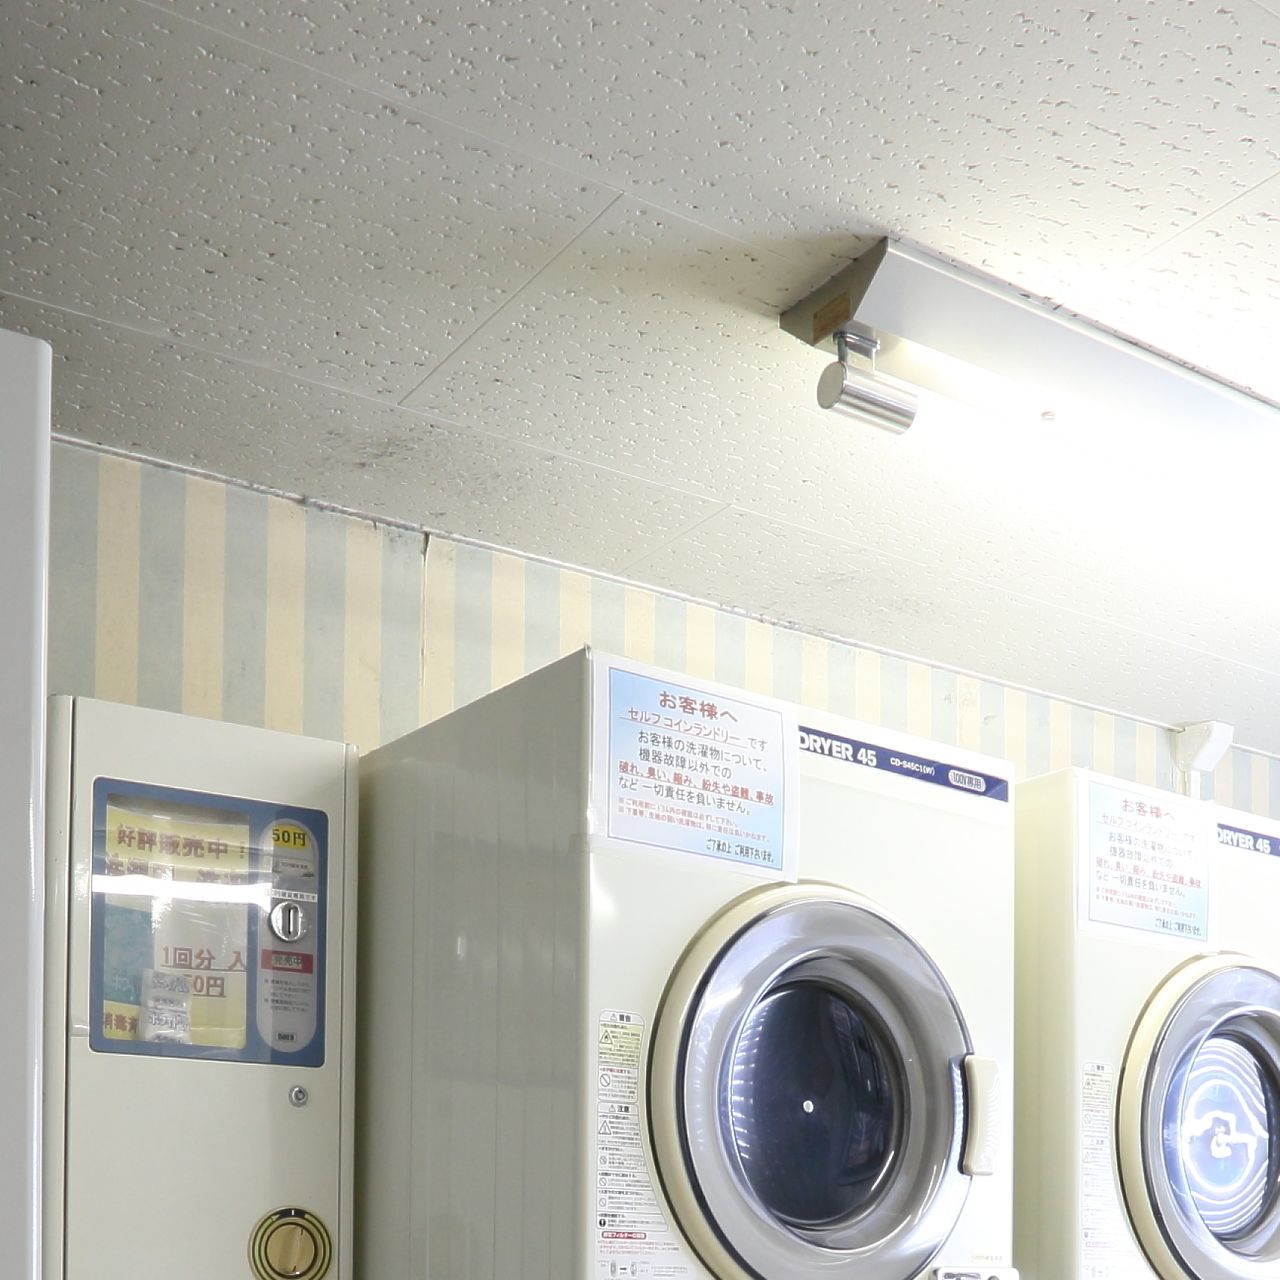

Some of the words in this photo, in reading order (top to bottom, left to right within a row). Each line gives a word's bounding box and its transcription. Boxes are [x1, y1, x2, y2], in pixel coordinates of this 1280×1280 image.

[659, 690, 739, 723] お客様へ
[638, 730, 768, 773] お客様の洗濯物について、
[747, 737, 769, 752] です
[798, 731, 854, 761] DRYER
[857, 748, 877, 767] 45
[638, 747, 733, 780] 機器故障以外での
[272, 828, 306, 847] 50円
[1217, 827, 1255, 851] DRYER
[1256, 837, 1271, 855] 45
[162, 946, 216, 969] 1回分
